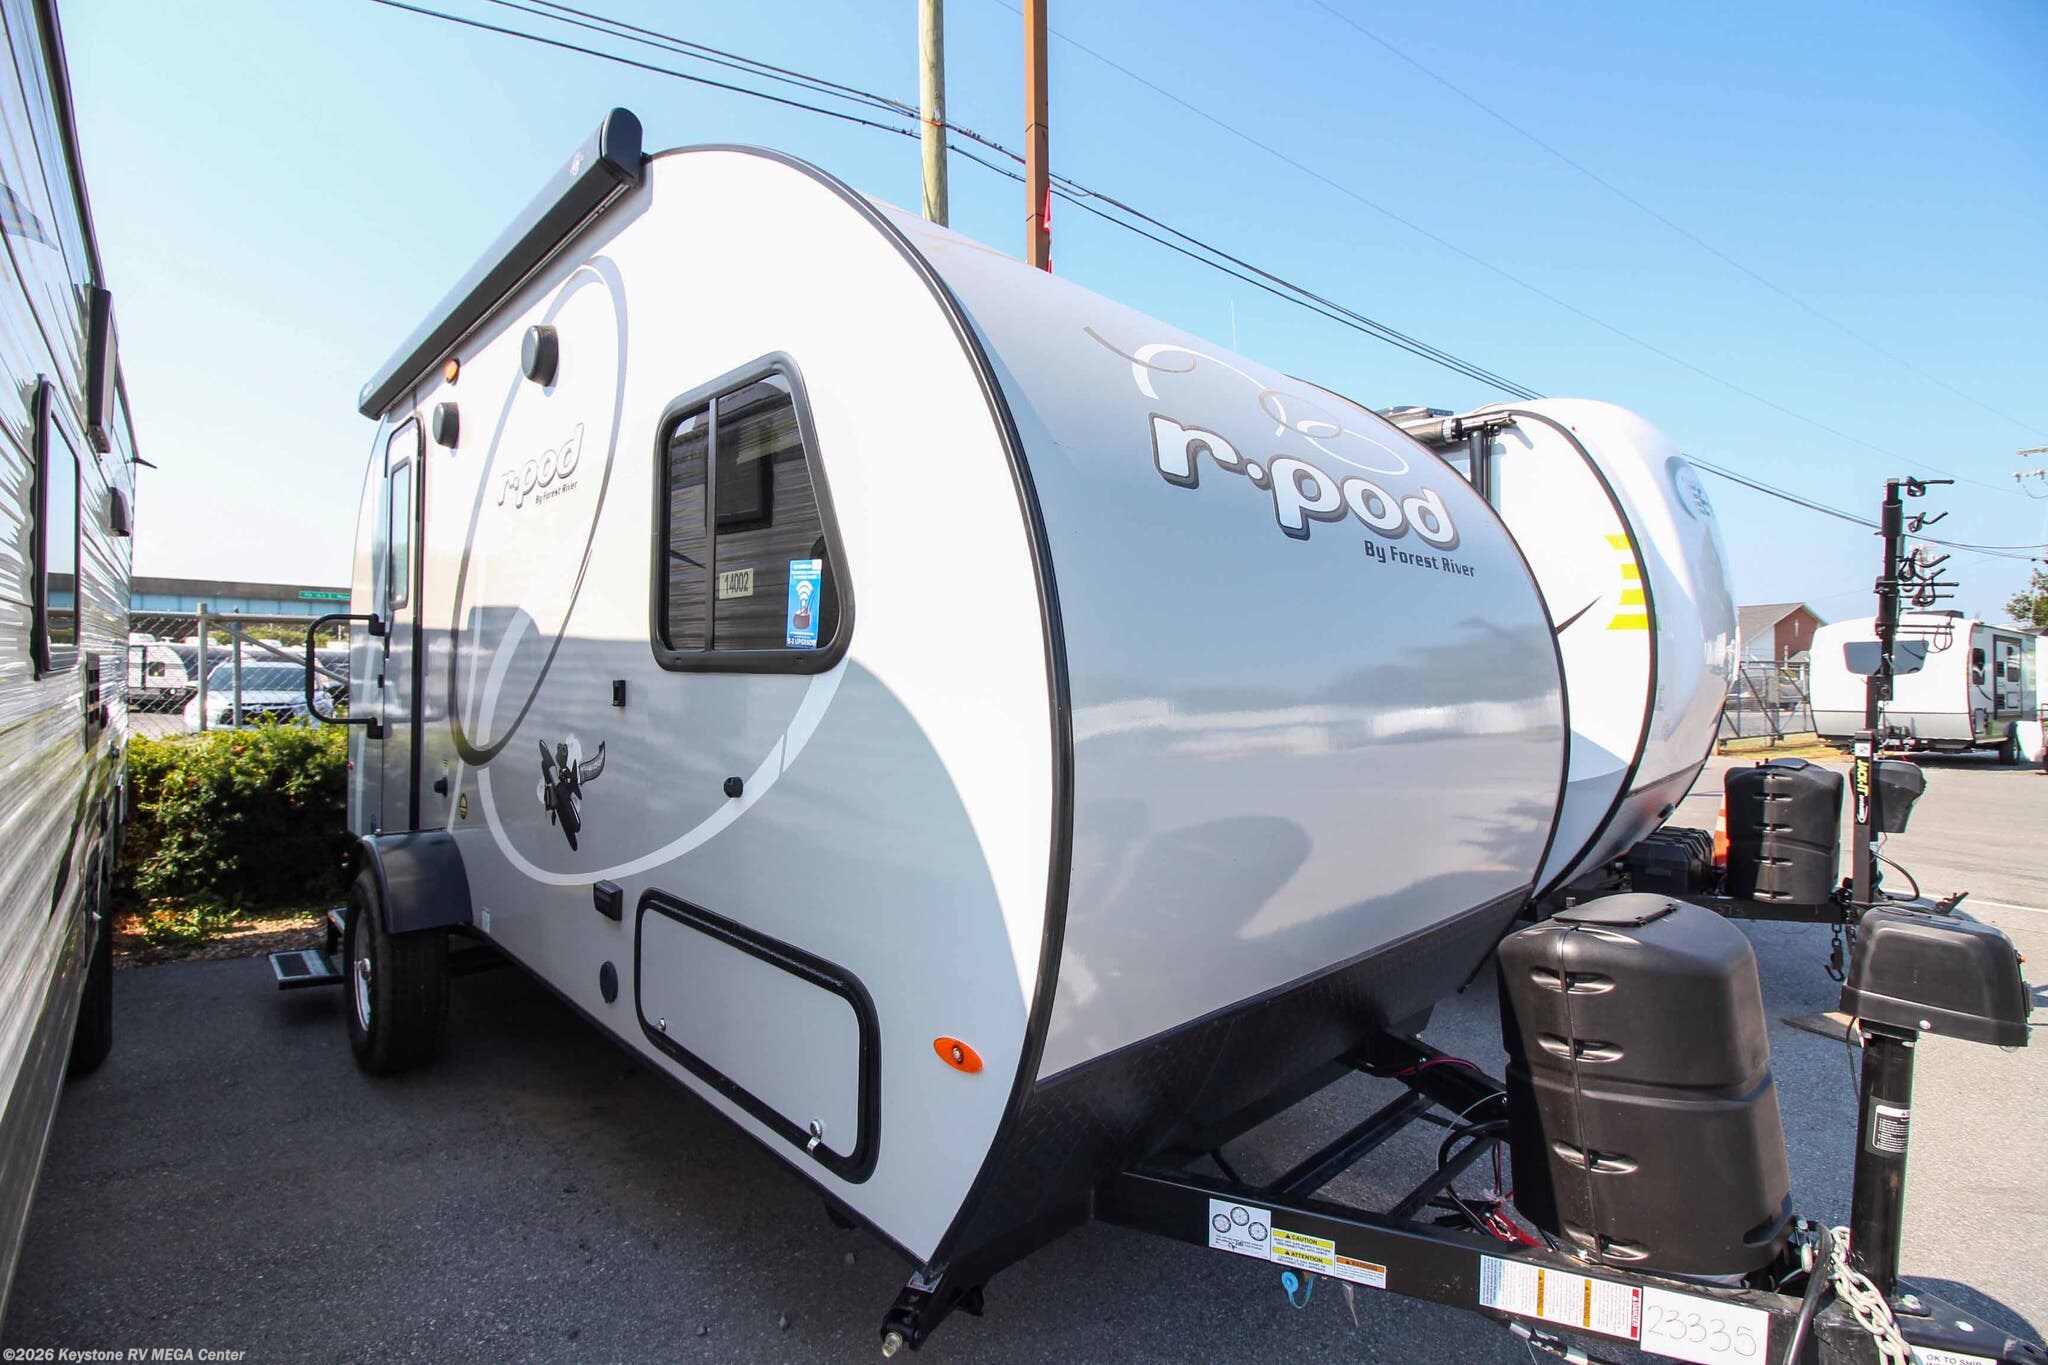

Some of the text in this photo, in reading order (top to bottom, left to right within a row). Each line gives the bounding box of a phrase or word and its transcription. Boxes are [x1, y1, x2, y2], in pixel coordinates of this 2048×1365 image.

[543, 487, 561, 500] Forest
[562, 480, 577, 493] River
[1364, 540, 1474, 577] By Forest River
[723, 571, 750, 595] 14002
[1857, 759, 1869, 797] JACK-IT
[1291, 1234, 1318, 1246] CAUTION
[1290, 1250, 1323, 1263] ATTENTION
[1631, 1301, 1639, 1327] DANGER
[1647, 1304, 1757, 1358] 23335
[1926, 1354, 1940, 1362] OK
[1944, 1356, 1957, 1364] TO
